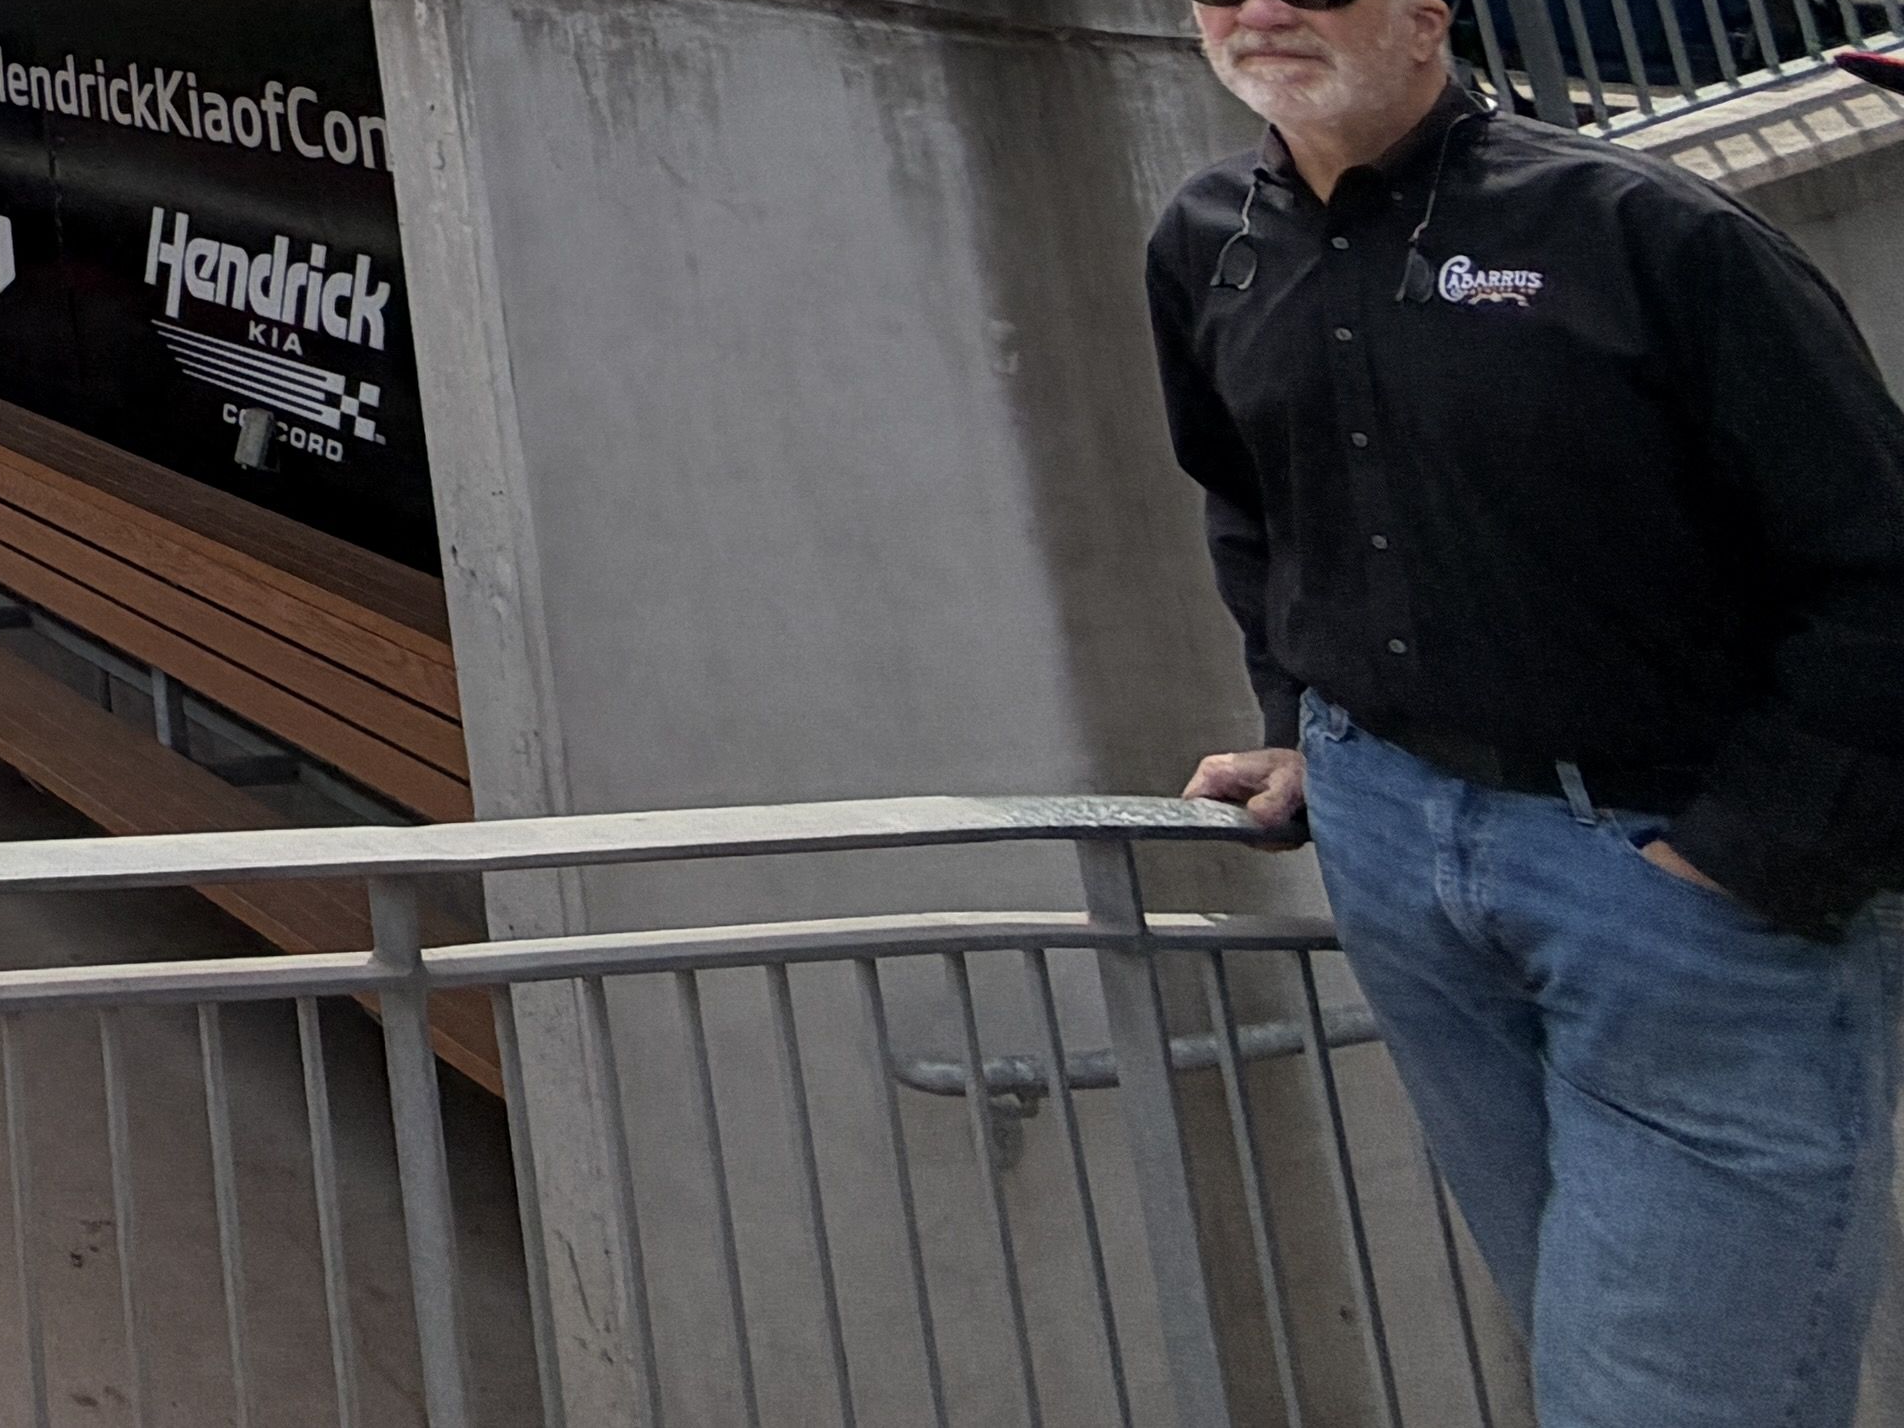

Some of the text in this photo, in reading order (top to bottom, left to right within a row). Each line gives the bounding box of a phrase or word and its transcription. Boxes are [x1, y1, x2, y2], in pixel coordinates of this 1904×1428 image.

[144, 205, 392, 352] Hendrick
[247, 319, 304, 357] KIA
[222, 402, 344, 463] CCORD
